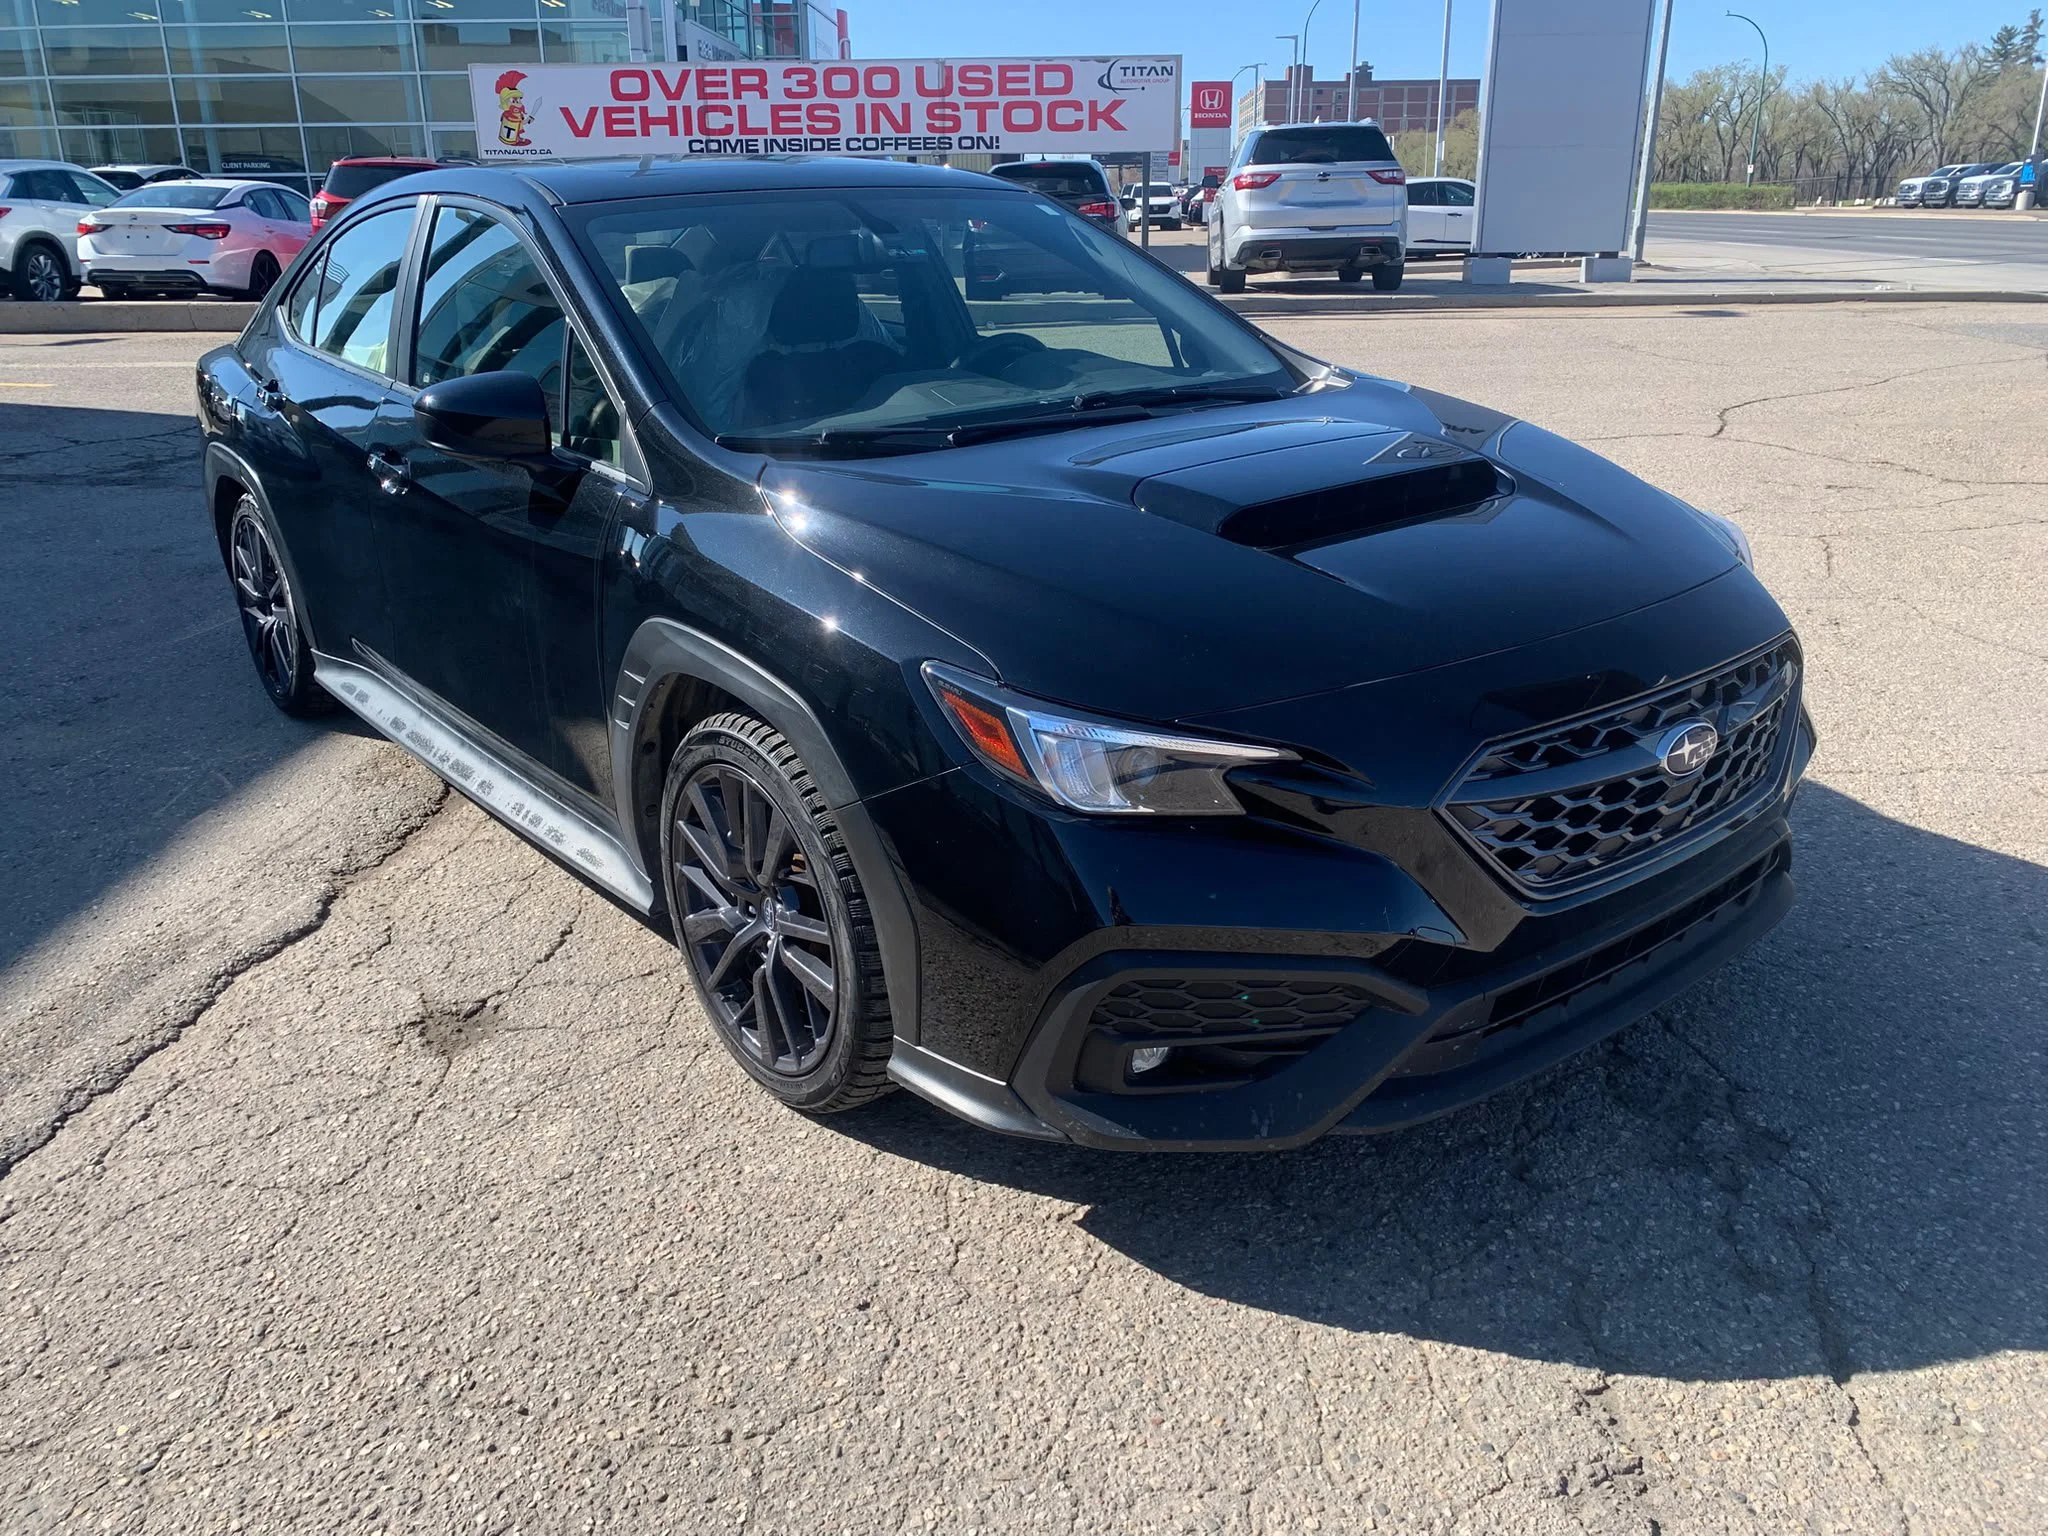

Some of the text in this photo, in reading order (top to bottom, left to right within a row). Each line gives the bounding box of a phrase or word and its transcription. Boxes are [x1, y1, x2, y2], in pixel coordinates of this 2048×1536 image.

[1119, 65, 1174, 77] TITAN
[610, 64, 1074, 102] OVER 300 USED
[559, 99, 1129, 138] VEHICLES IN STOCK
[503, 125, 516, 139] T
[688, 135, 1000, 154] COME INSIDE COFFEES ON!
